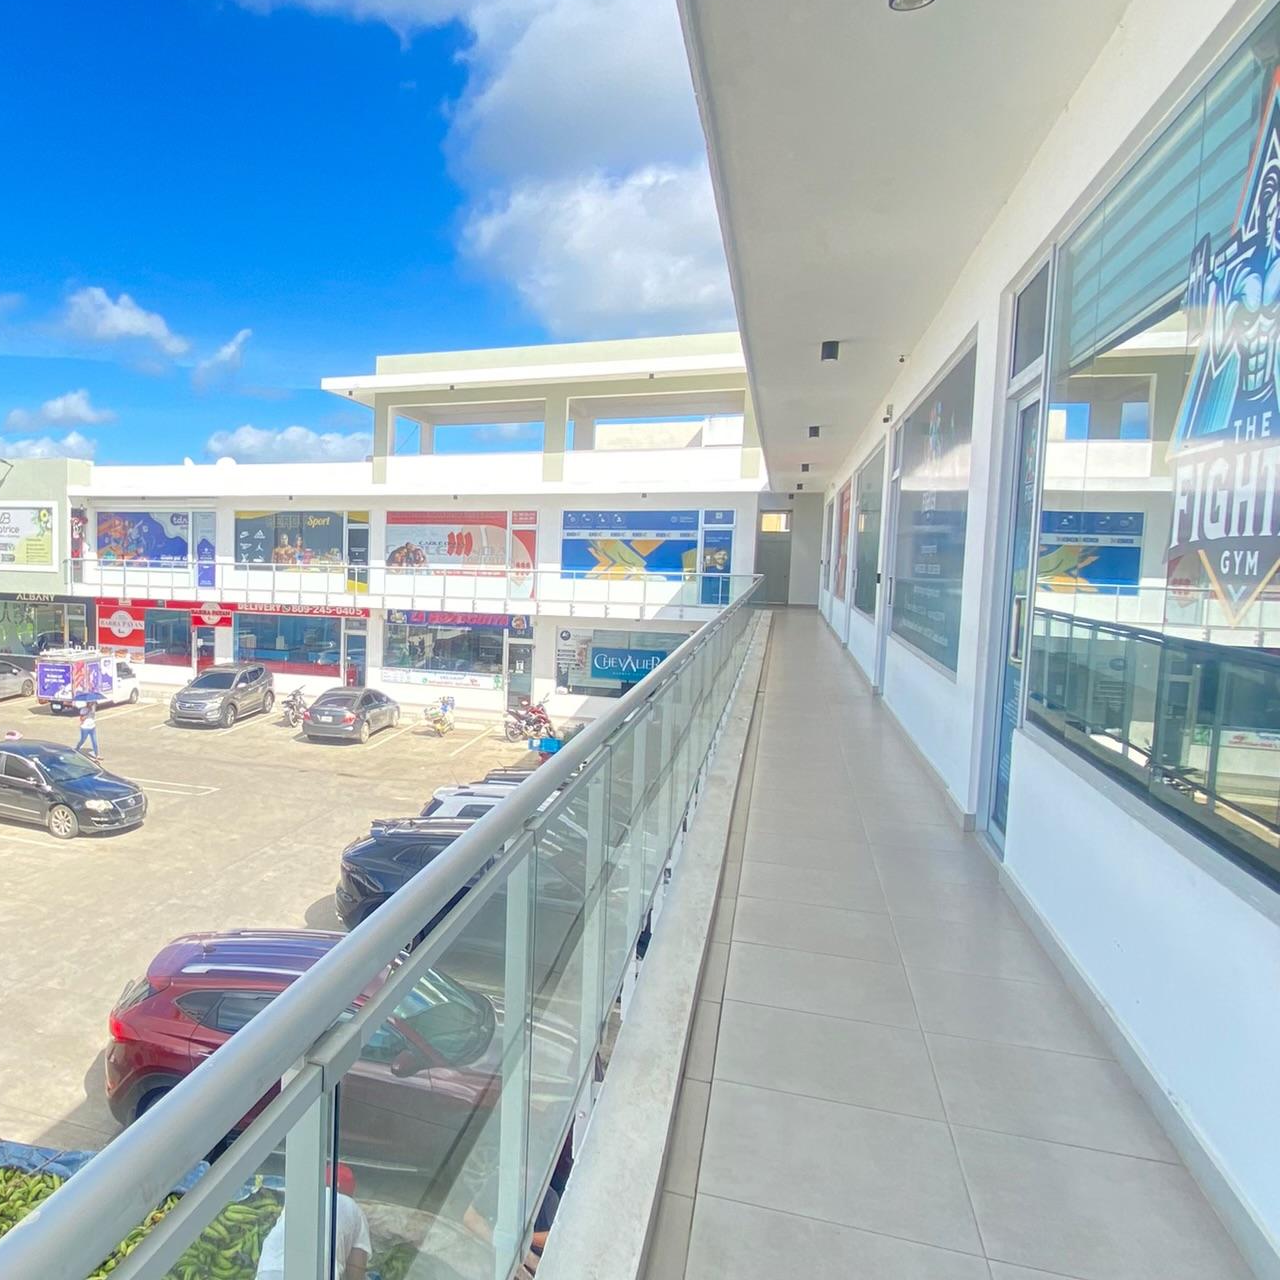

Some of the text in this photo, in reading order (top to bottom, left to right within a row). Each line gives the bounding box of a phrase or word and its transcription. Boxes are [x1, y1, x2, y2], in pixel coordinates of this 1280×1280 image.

[1233, 410, 1272, 445] THE
[307, 515, 331, 528] Sport
[1220, 550, 1260, 577] GYM
[16, 592, 56, 602] ALBANY
[237, 601, 281, 612] DELIVERY
